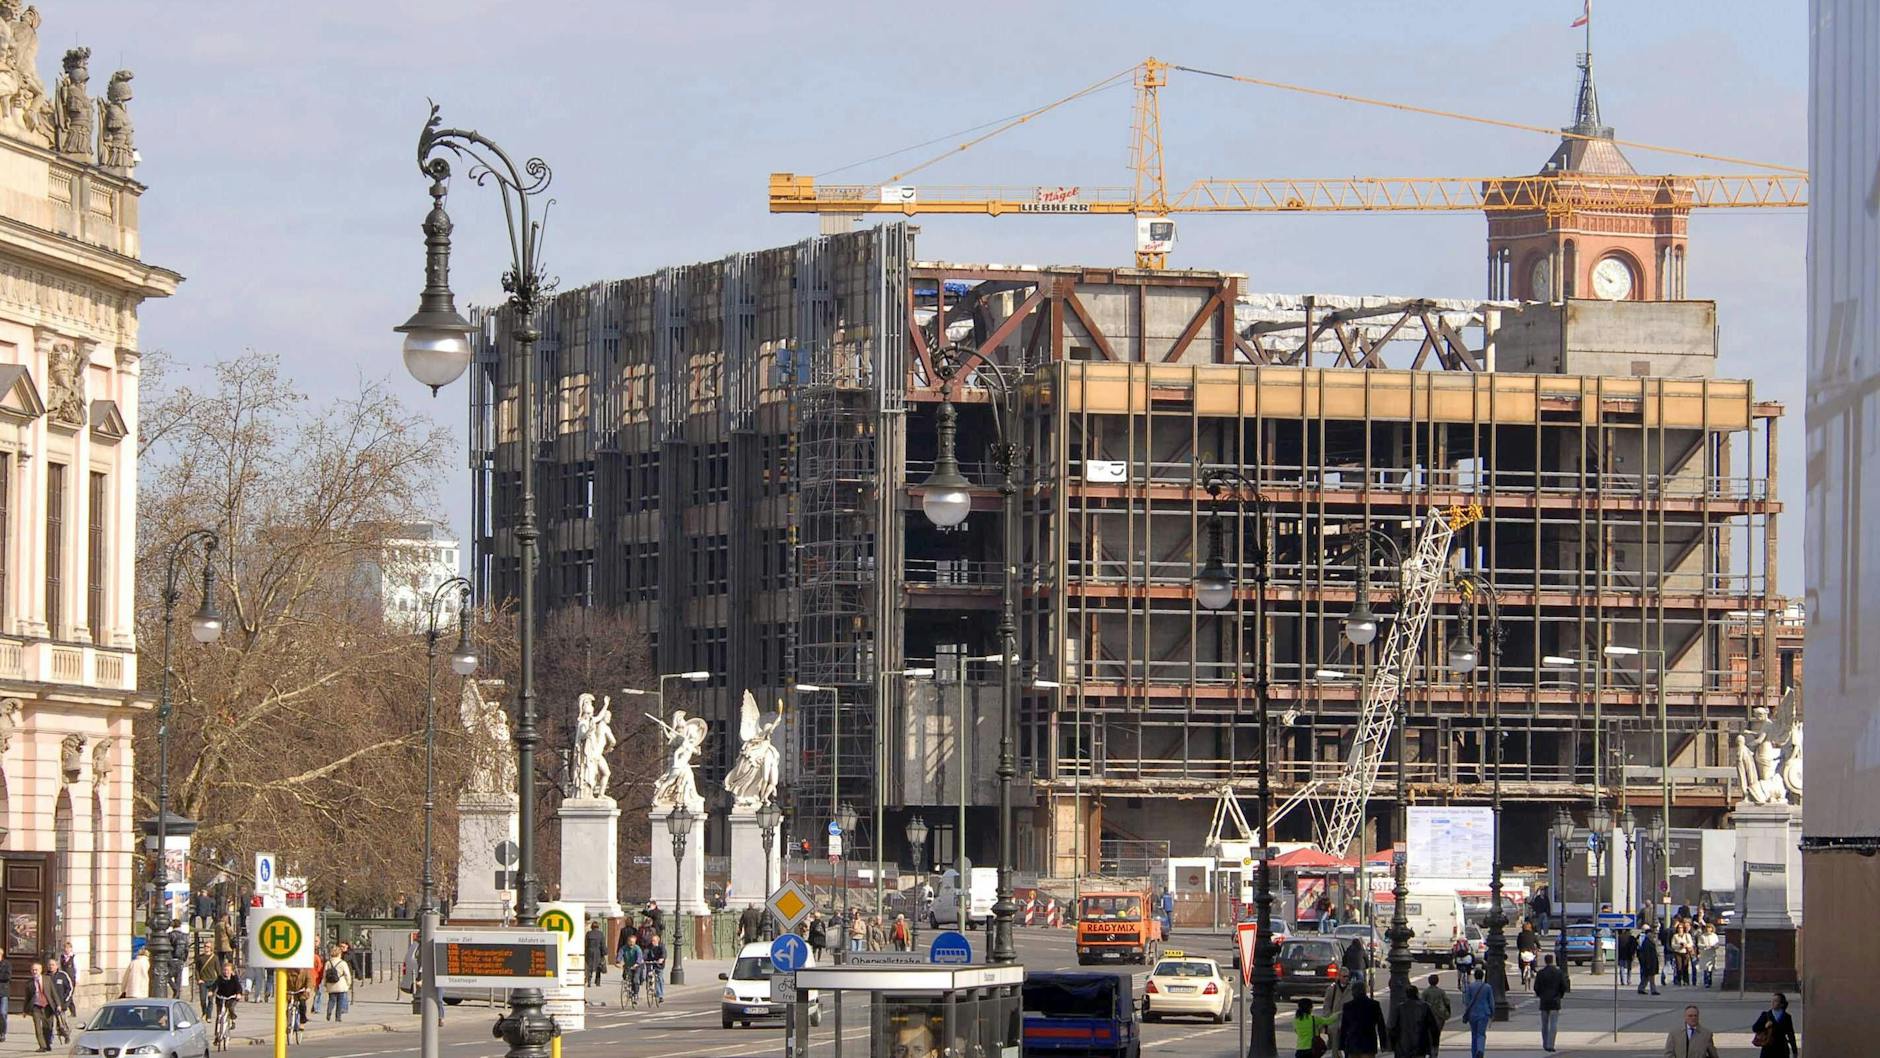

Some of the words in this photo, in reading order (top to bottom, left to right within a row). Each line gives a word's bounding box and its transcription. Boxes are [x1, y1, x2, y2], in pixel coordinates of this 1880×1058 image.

[1021, 203, 1088, 212] LIEBHERR
[1087, 923, 1136, 932] READYMIX
[270, 926, 290, 950] H
[782, 992, 795, 1000] frei
